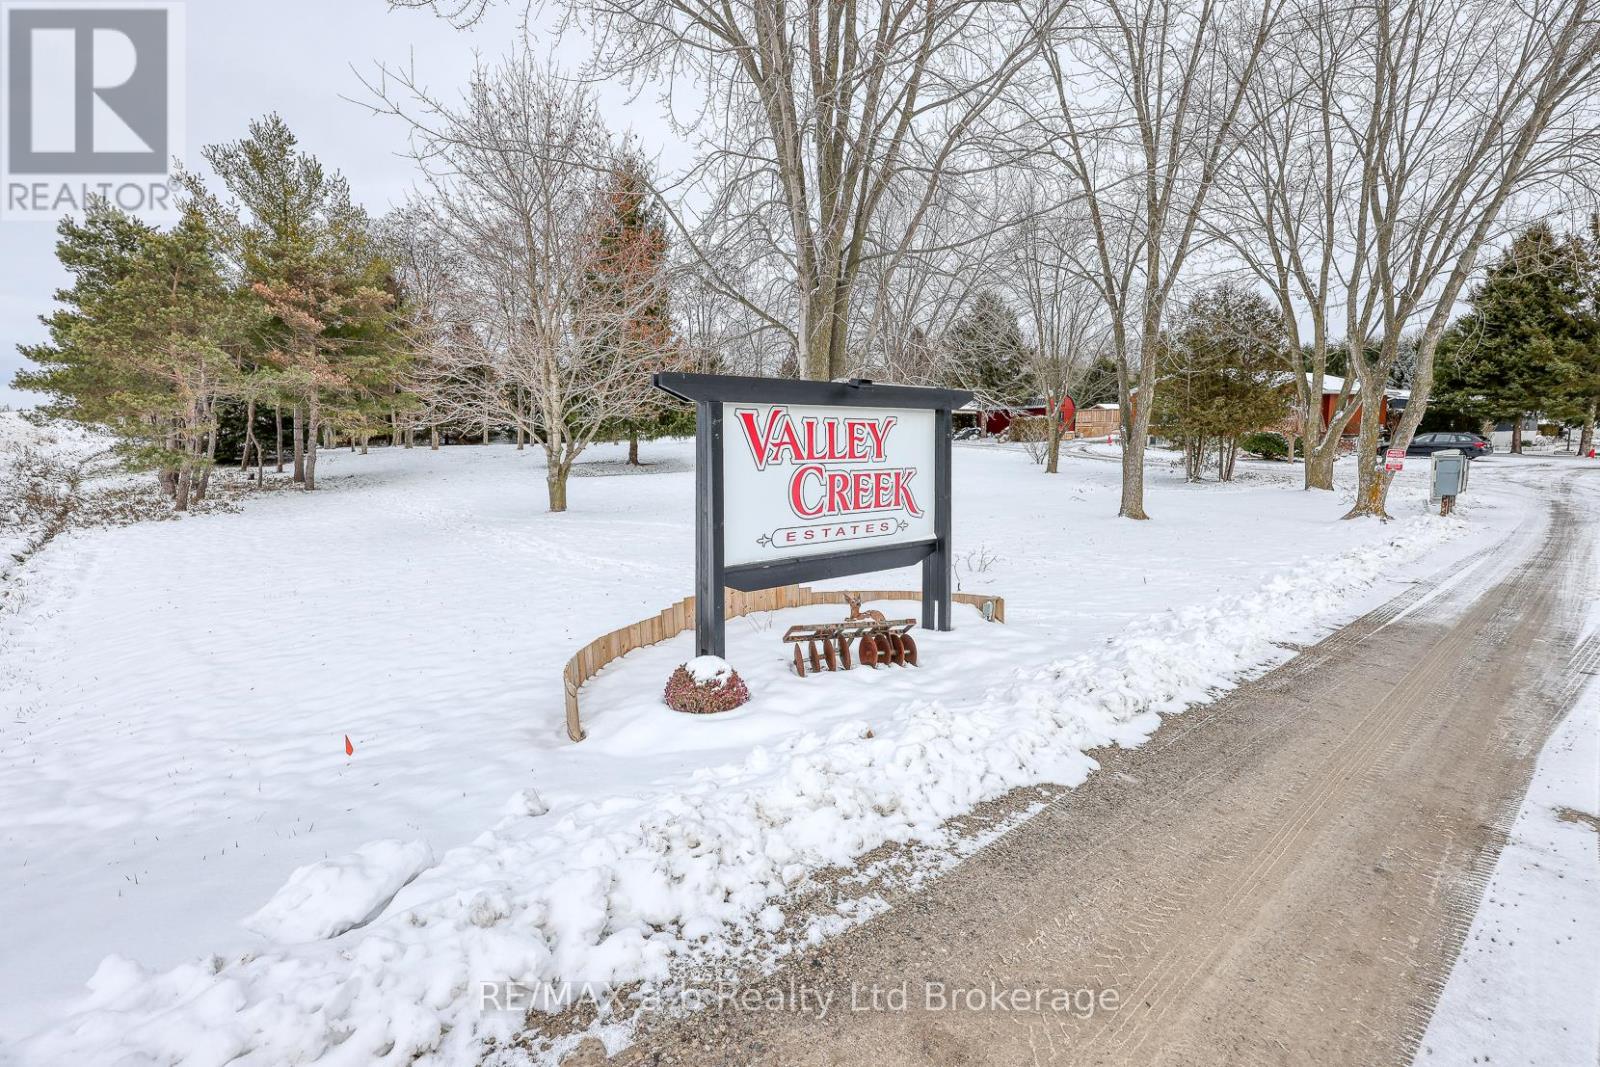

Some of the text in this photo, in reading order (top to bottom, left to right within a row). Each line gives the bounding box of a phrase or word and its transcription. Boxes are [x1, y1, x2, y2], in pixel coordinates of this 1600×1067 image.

[734, 405, 898, 471] VALLEY
[788, 463, 925, 520] CREEK
[786, 522, 889, 542] ESTATES
